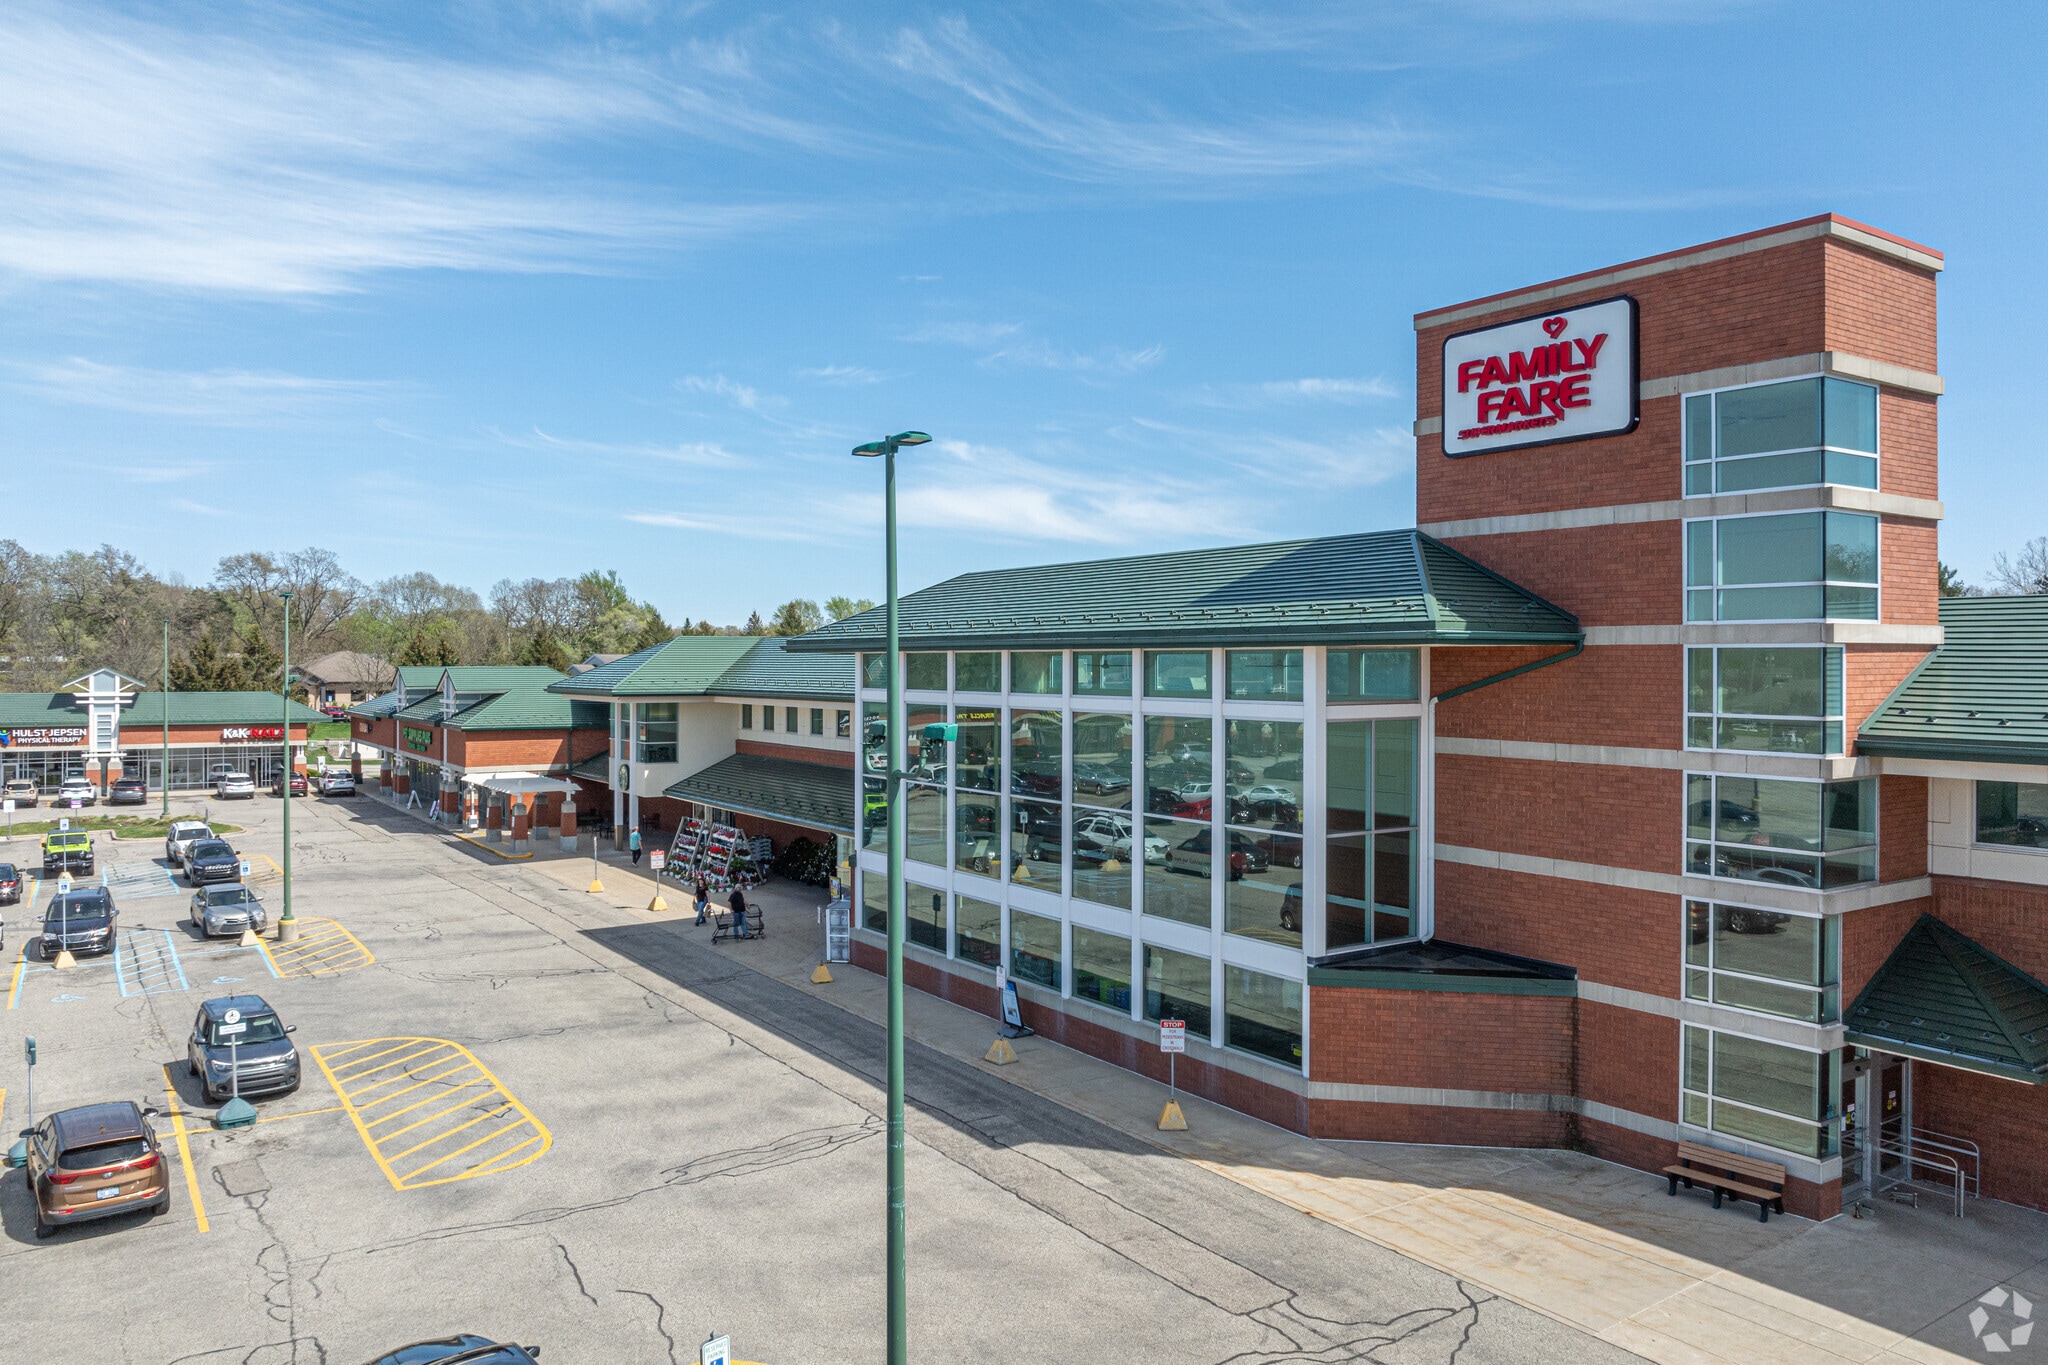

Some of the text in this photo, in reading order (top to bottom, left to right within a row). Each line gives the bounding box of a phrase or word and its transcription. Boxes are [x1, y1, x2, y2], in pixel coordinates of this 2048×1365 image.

[1457, 333, 1608, 393] FAMILY
[1477, 373, 1592, 423] FARE
[1457, 415, 1557, 439] SUPERMARKETS
[12, 728, 87, 737] HULST JEPSEN
[223, 728, 248, 739] K&K
[705, 1341, 727, 1353] RESERVED
[707, 1349, 726, 1360] PARKING
